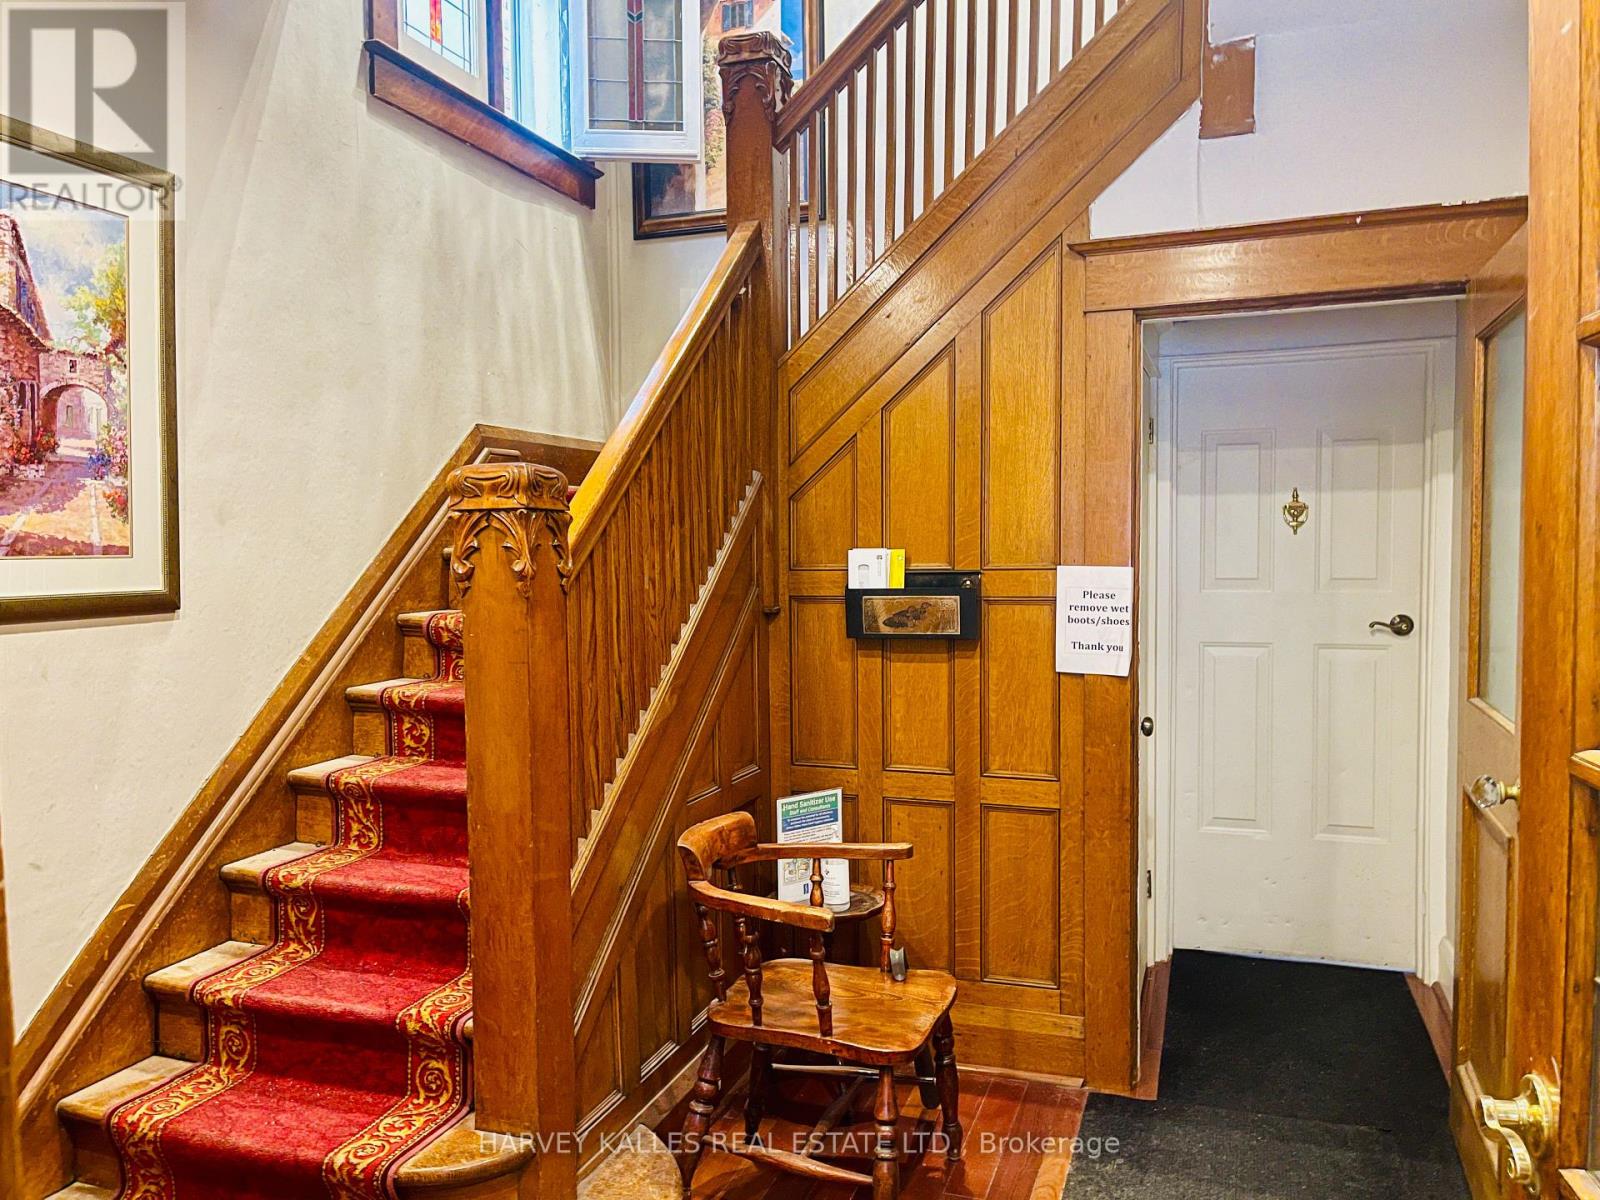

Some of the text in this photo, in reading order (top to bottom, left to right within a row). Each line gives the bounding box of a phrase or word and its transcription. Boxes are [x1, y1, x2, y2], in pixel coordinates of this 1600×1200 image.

[1082, 590, 1116, 600] Please
[1069, 604, 1129, 613] remove wet
[1067, 615, 1130, 627] boots/shoes
[1071, 641, 1124, 653] Thank you
[783, 801, 799, 811] Hand
[800, 798, 824, 808] Sanitizer
